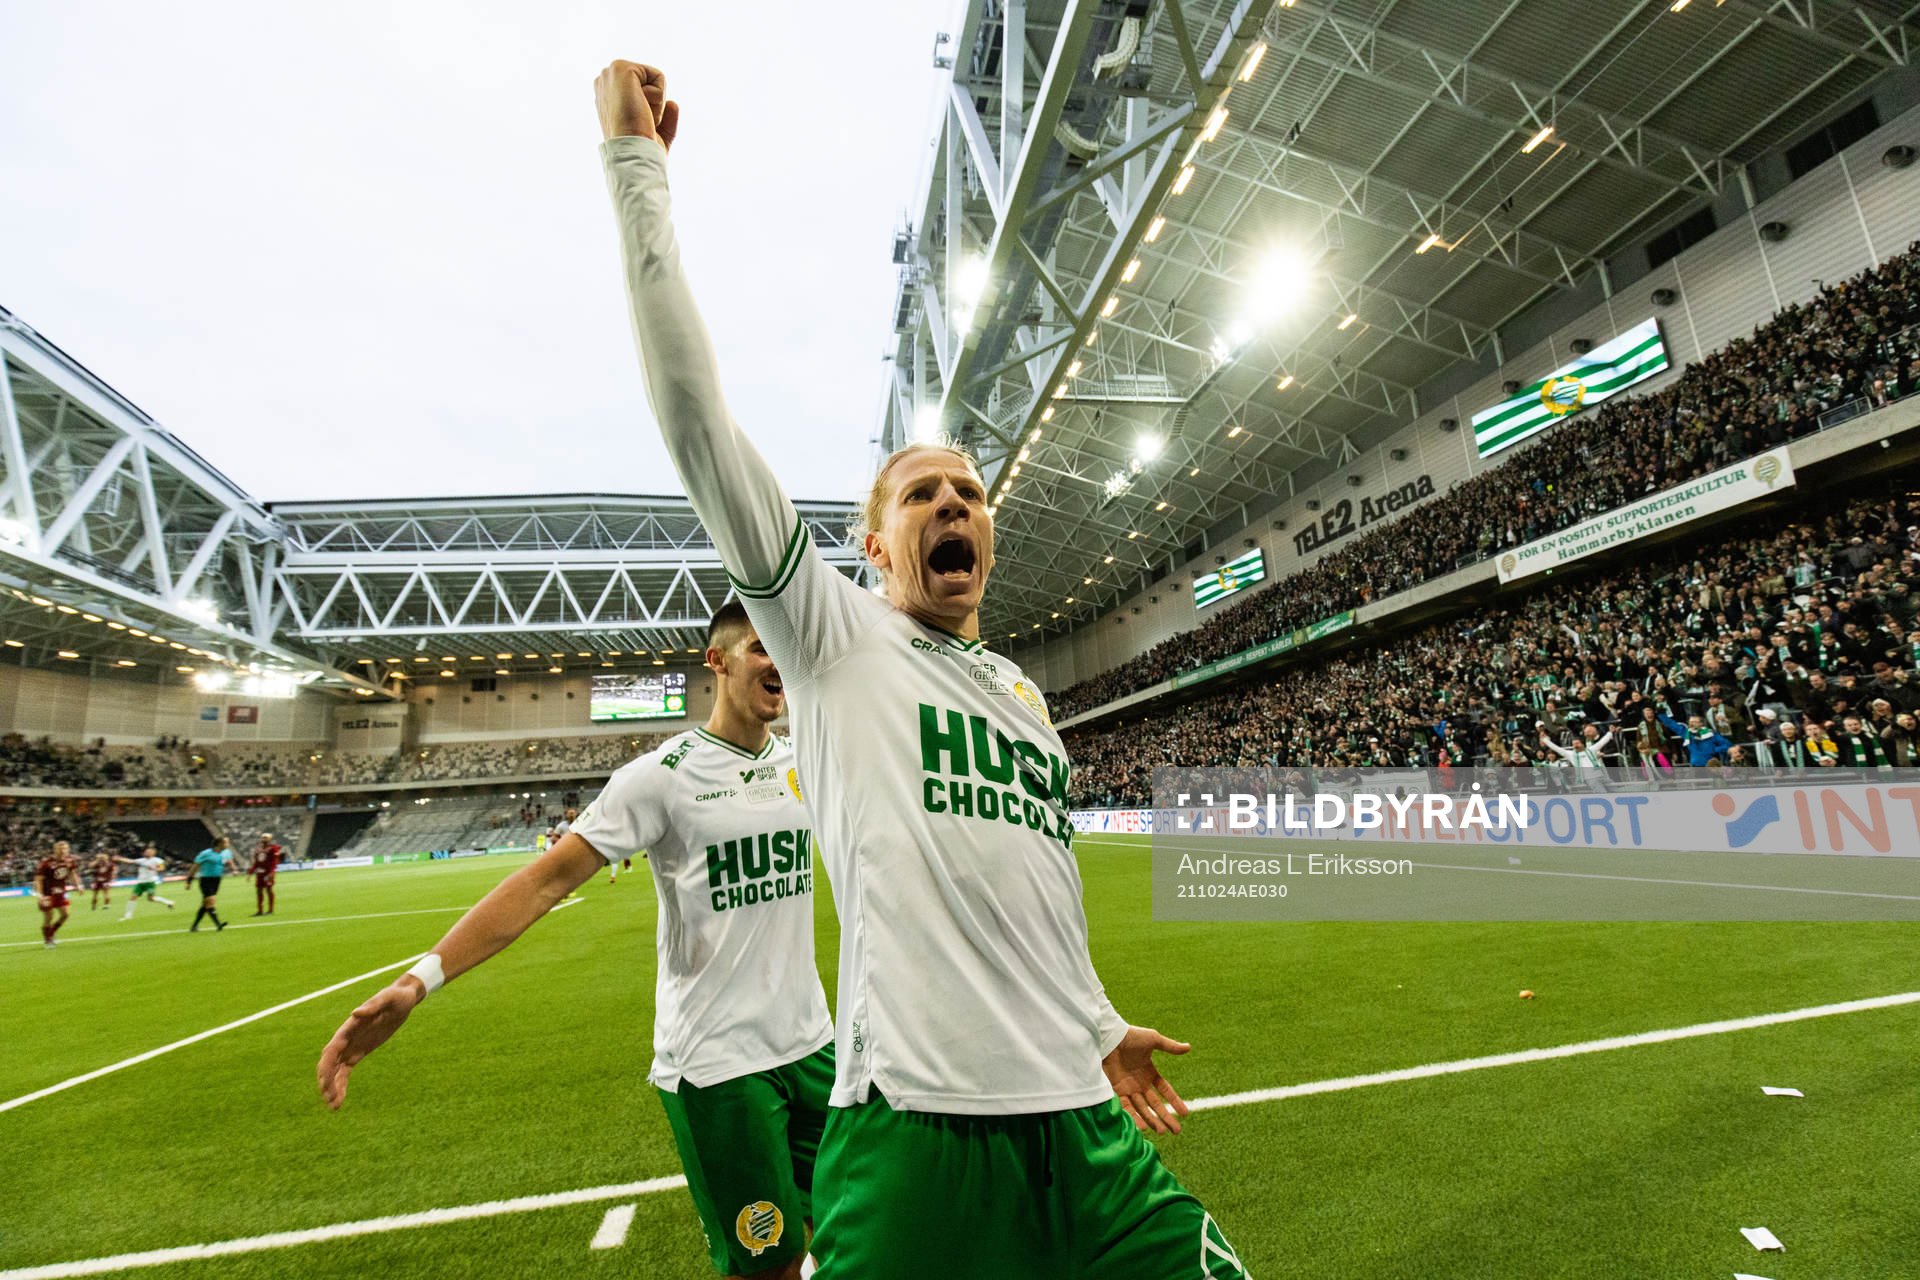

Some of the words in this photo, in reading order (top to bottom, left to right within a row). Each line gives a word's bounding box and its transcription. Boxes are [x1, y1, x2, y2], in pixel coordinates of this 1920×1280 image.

[1293, 499, 1356, 556] TELE2
[1360, 474, 1436, 528] Arena
[1542, 539, 1556, 553] EN
[1560, 523, 1604, 546] POSITIV
[1607, 469, 1747, 528] SUPPORTERKULTUR
[1558, 505, 1697, 560] Hammarbyklanen
[755, 766, 776, 775] INTER
[919, 703, 1070, 812] HUSK
[695, 790, 729, 802] CRAFT
[923, 777, 1076, 850] CHOCOLA
[1110, 811, 1178, 833] INTERSPORT
[706, 829, 811, 888] HUSKI
